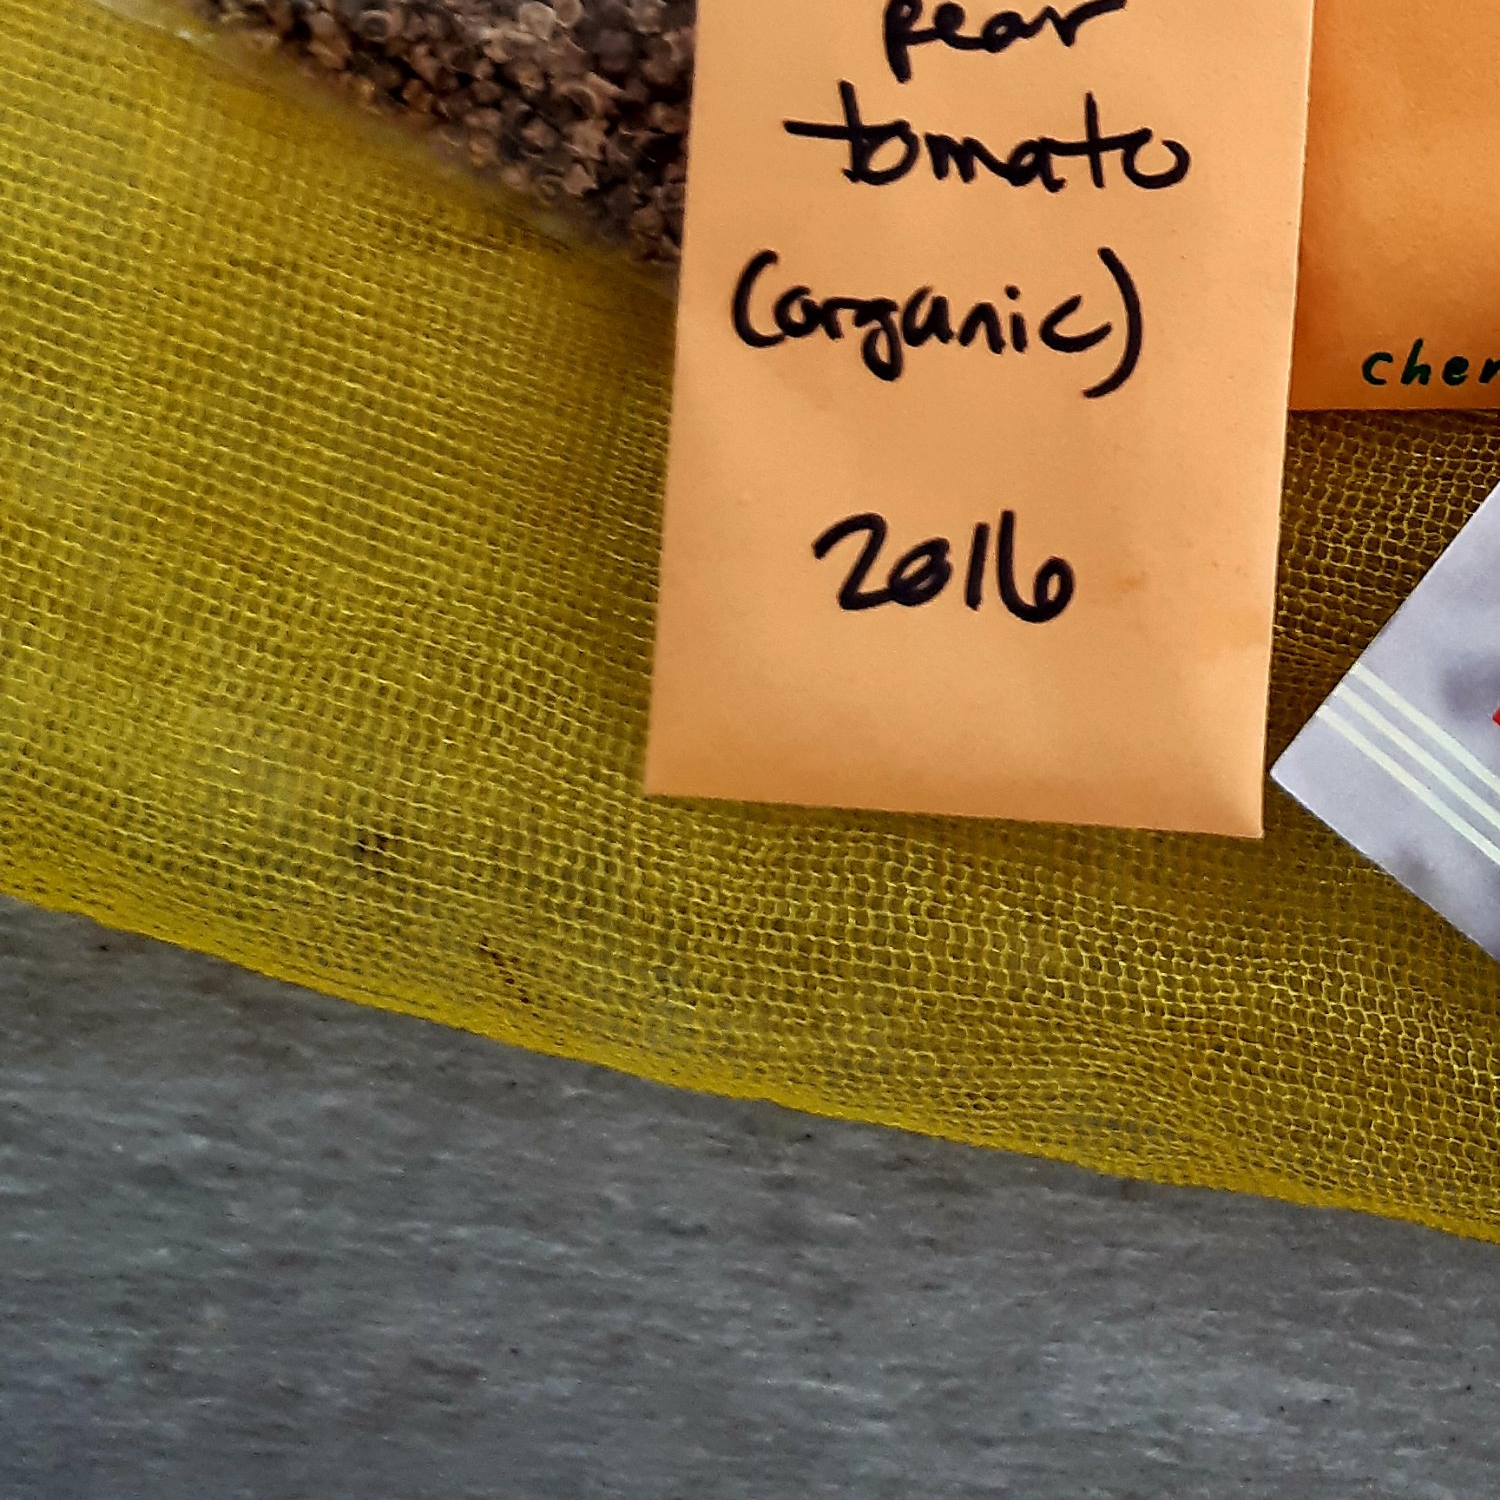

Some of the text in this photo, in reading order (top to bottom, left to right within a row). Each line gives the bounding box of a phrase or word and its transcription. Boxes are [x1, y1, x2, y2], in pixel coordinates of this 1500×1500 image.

[784, 80, 1192, 192] tomato
[732, 248, 1144, 399] (organic)
[812, 510, 1076, 623] 2016
